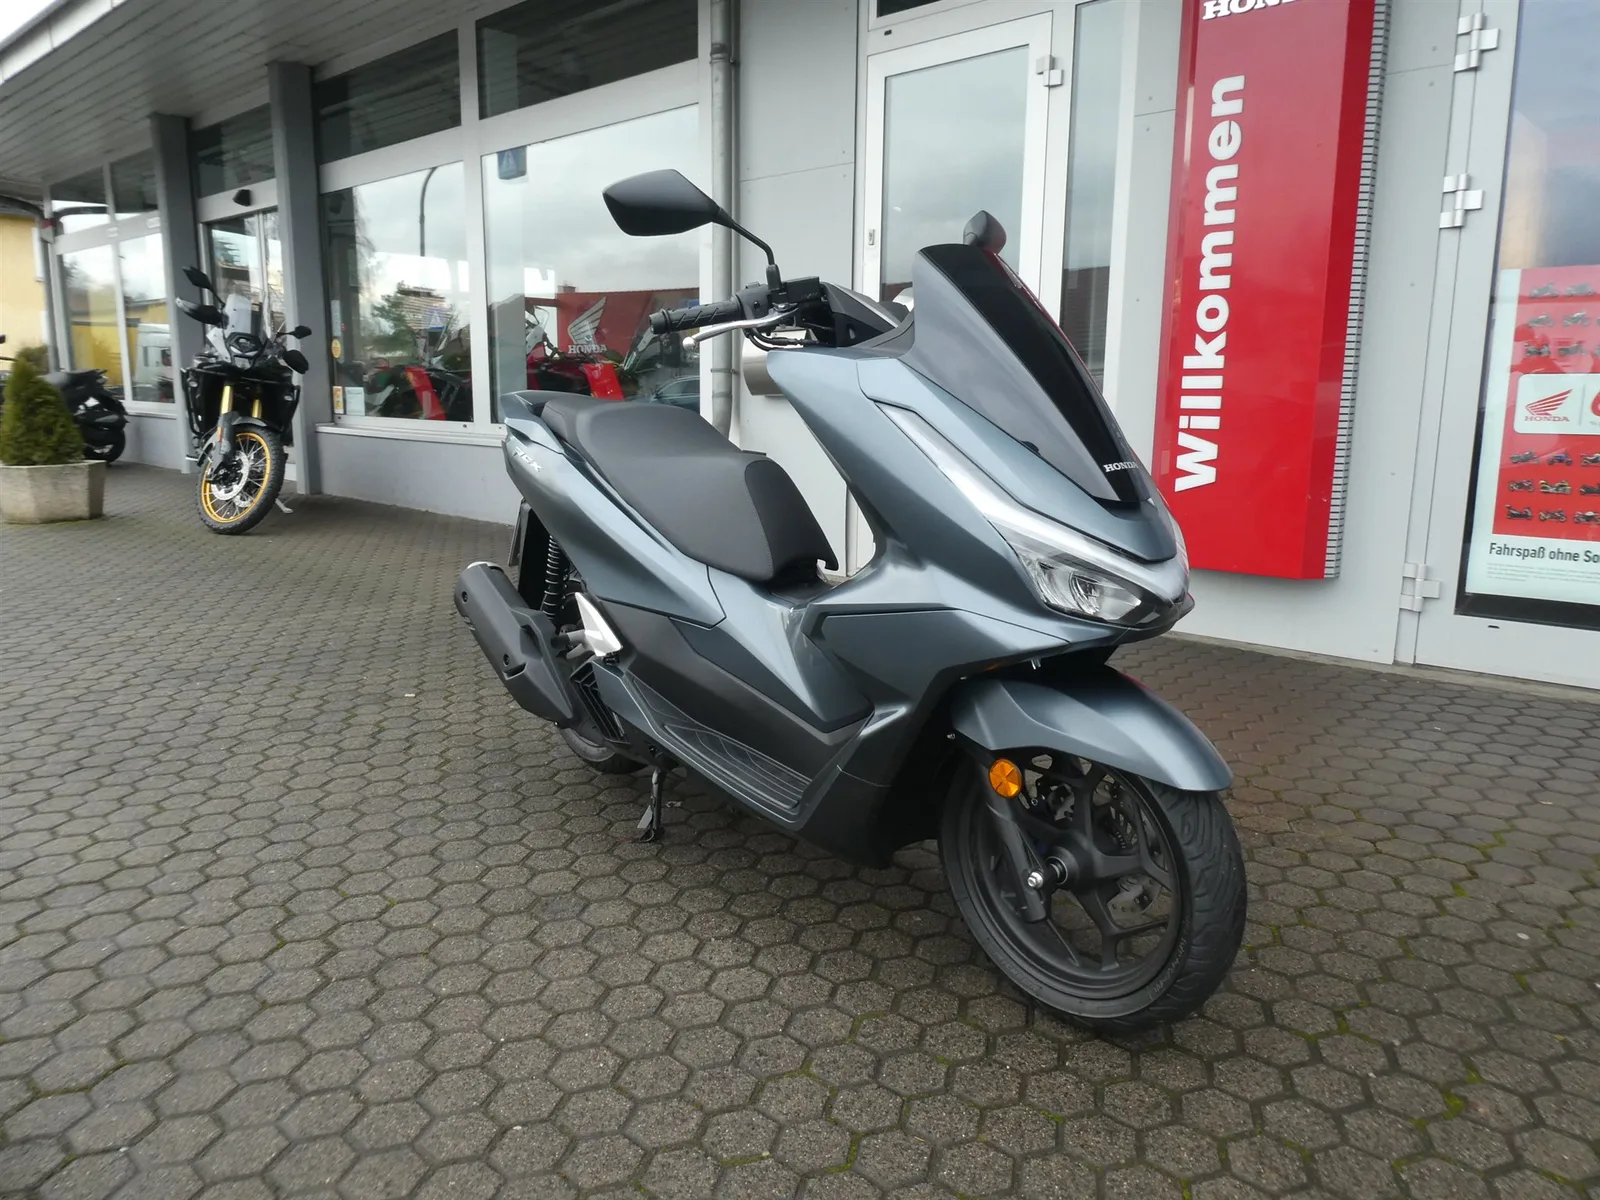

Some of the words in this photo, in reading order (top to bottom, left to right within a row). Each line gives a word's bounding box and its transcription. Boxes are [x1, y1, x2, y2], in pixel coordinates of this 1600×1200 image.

[1174, 74, 1246, 492] Willkommen
[567, 344, 607, 354] HONDA
[1523, 415, 1571, 423] HONDA
[1103, 461, 1139, 473] HONDA
[1489, 542, 1546, 560] Fahrspaß
[1548, 548, 1580, 562] ohne
